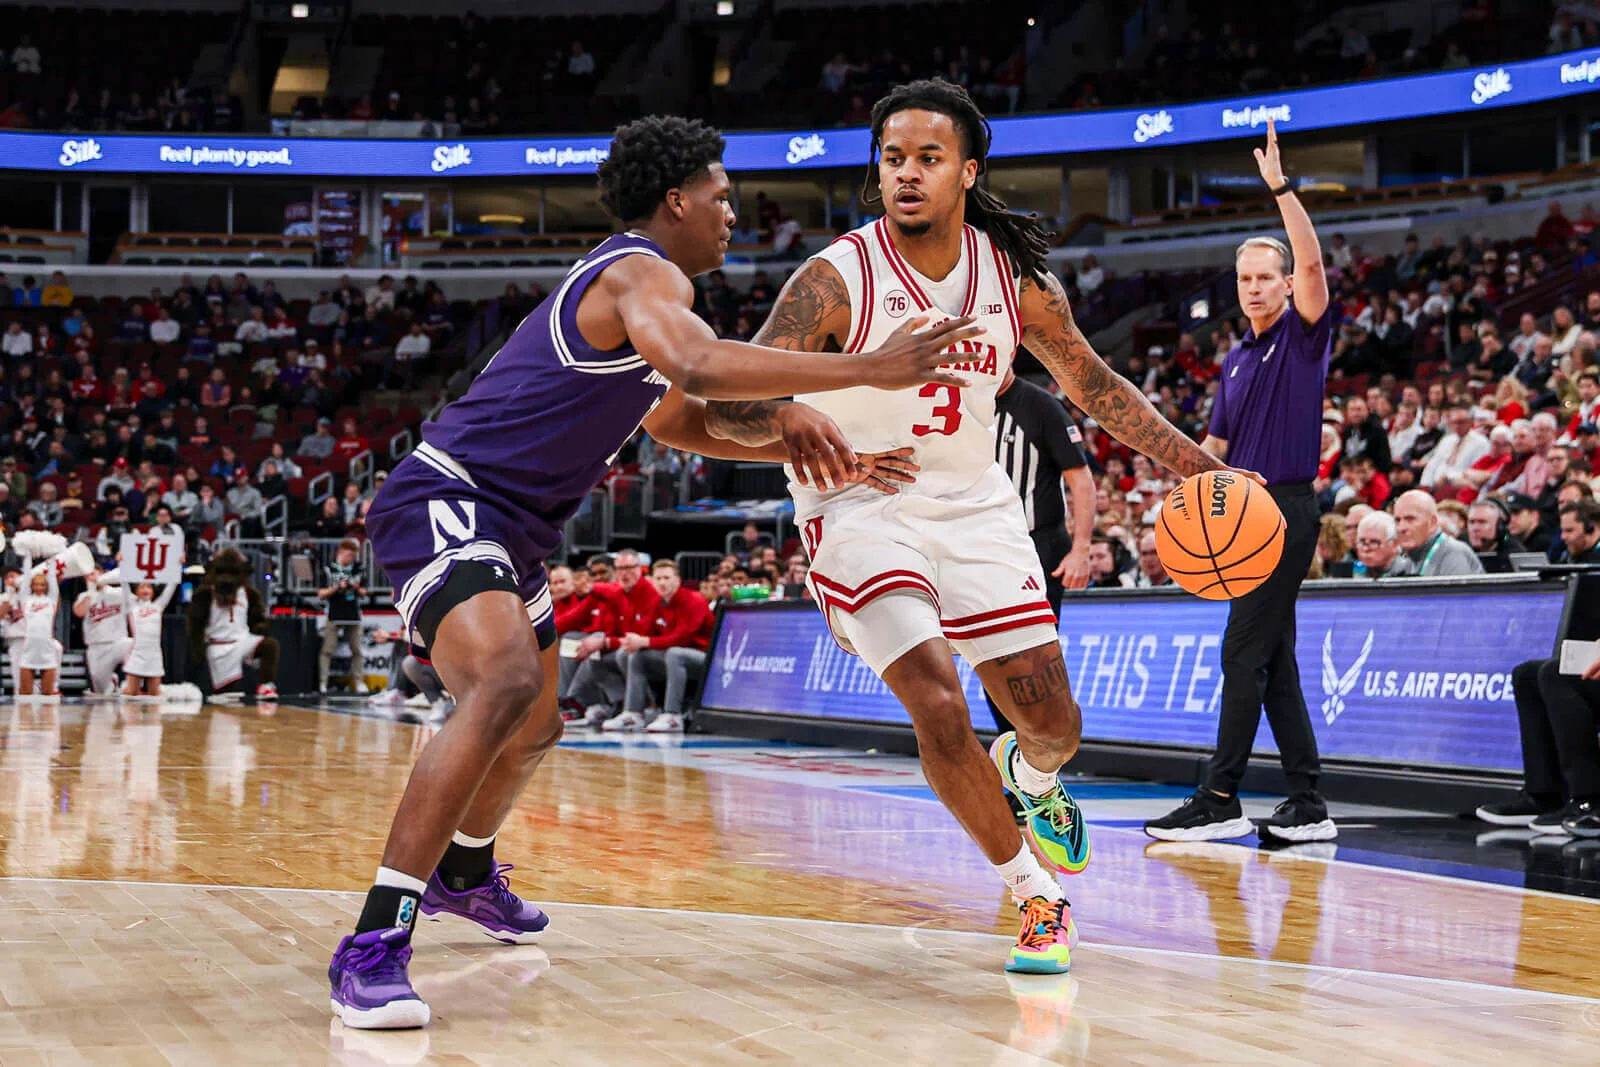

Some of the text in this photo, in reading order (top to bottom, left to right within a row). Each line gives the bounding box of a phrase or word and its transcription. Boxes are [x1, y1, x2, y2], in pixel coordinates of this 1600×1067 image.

[1471, 68, 1512, 104] Silk
[1134, 110, 1174, 143] Silk
[1222, 106, 1251, 128] Feel
[59, 139, 102, 166] Silk
[160, 145, 192, 162] Feel
[431, 143, 472, 172] Silk
[526, 147, 556, 165] Feel
[786, 133, 827, 165] Silk
[912, 382, 962, 437] 3
[1211, 470, 1236, 518] ilson
[428, 499, 476, 554] N
[1074, 634, 1158, 709] THIS
[1363, 670, 1398, 697] U.S.
[1400, 671, 1441, 699] AIR
